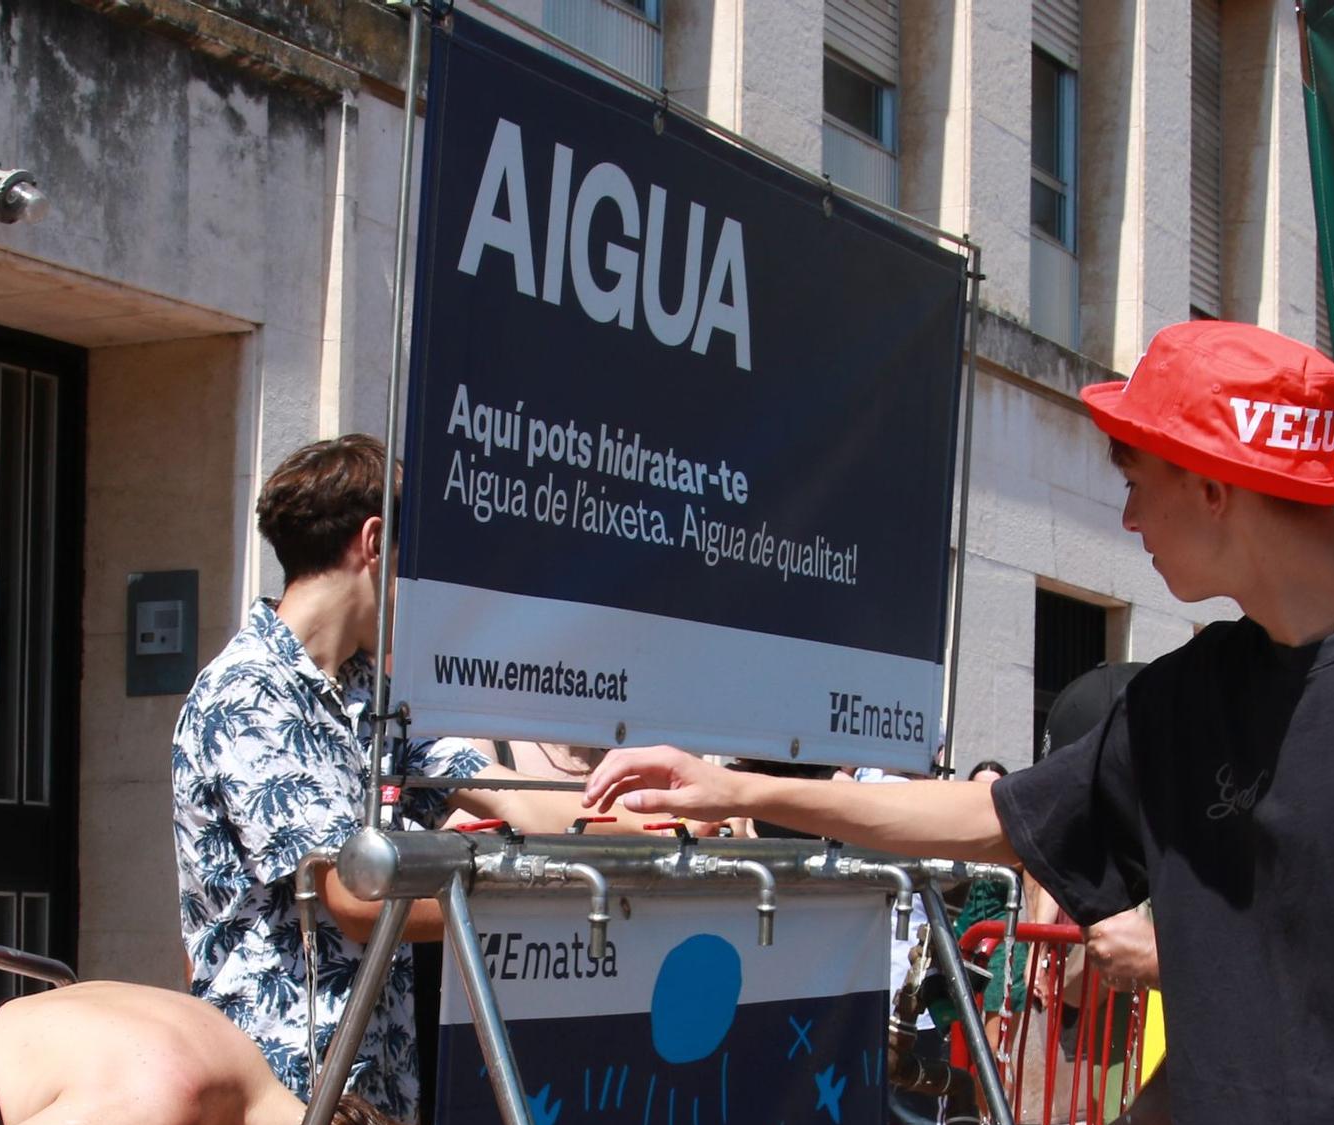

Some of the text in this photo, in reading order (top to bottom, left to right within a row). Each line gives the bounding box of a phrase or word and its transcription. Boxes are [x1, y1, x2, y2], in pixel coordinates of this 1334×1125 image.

[457, 117, 752, 372] AIGUA
[447, 383, 749, 504] Aquí pots hidratar-te
[444, 450, 528, 523] Aigua
[534, 473, 568, 526] de
[681, 503, 745, 567] Aigua
[749, 521, 774, 568] de
[777, 535, 858, 586] qualitat!
[434, 654, 628, 702] www.ematsa.cat
[850, 694, 925, 744] Ematsa
